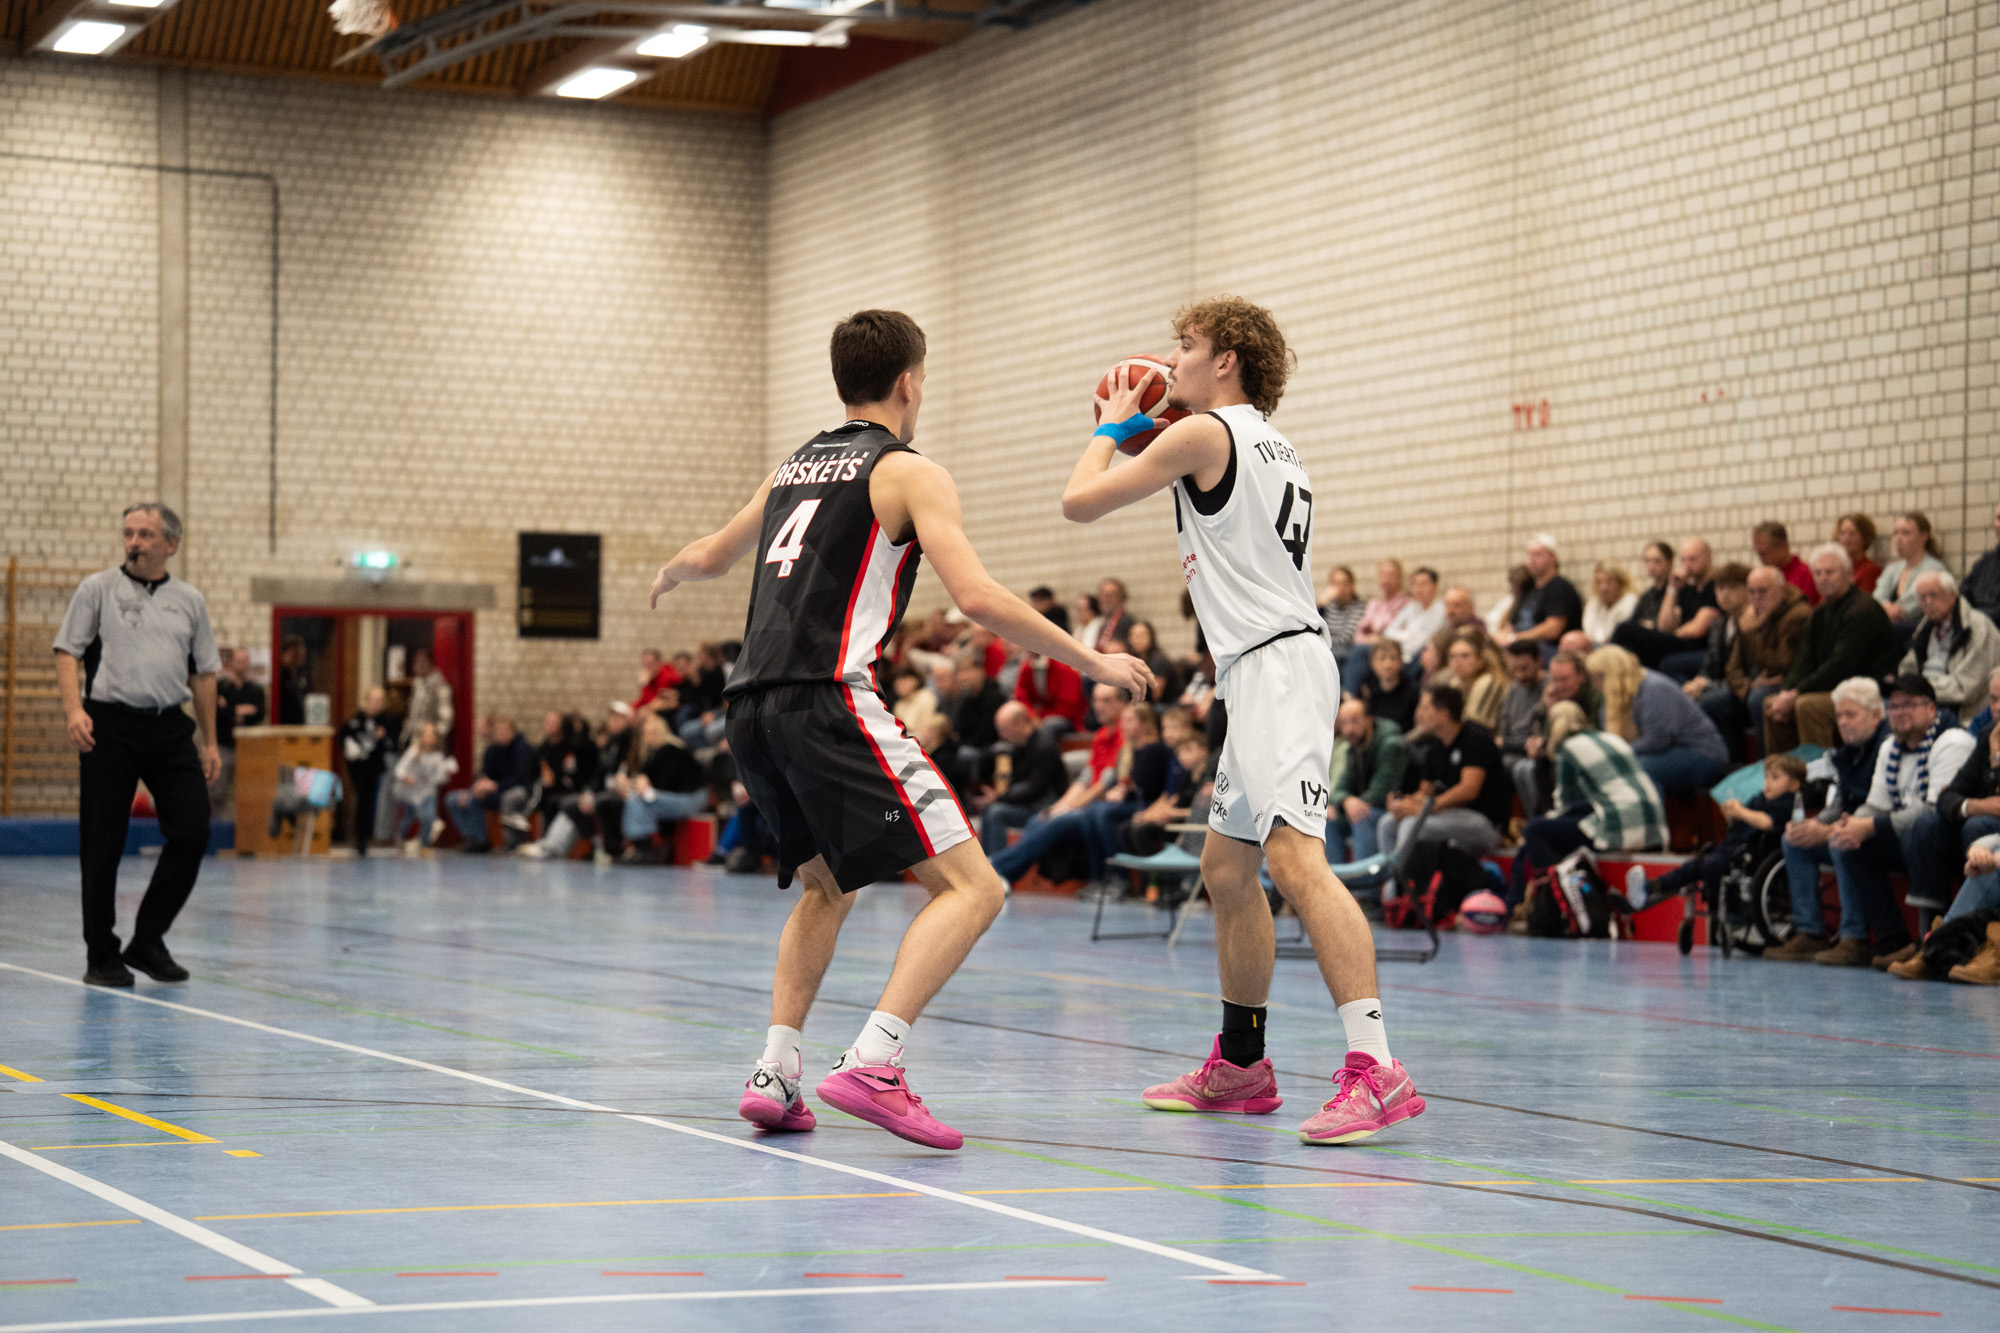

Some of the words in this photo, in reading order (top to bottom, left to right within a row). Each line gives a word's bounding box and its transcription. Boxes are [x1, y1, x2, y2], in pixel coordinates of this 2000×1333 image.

[1254, 440, 1276, 464] TV
[772, 458, 864, 489] BASKETS
[765, 499, 822, 578] 4
[1275, 481, 1312, 571] 47
[885, 809, 900, 822] 43
